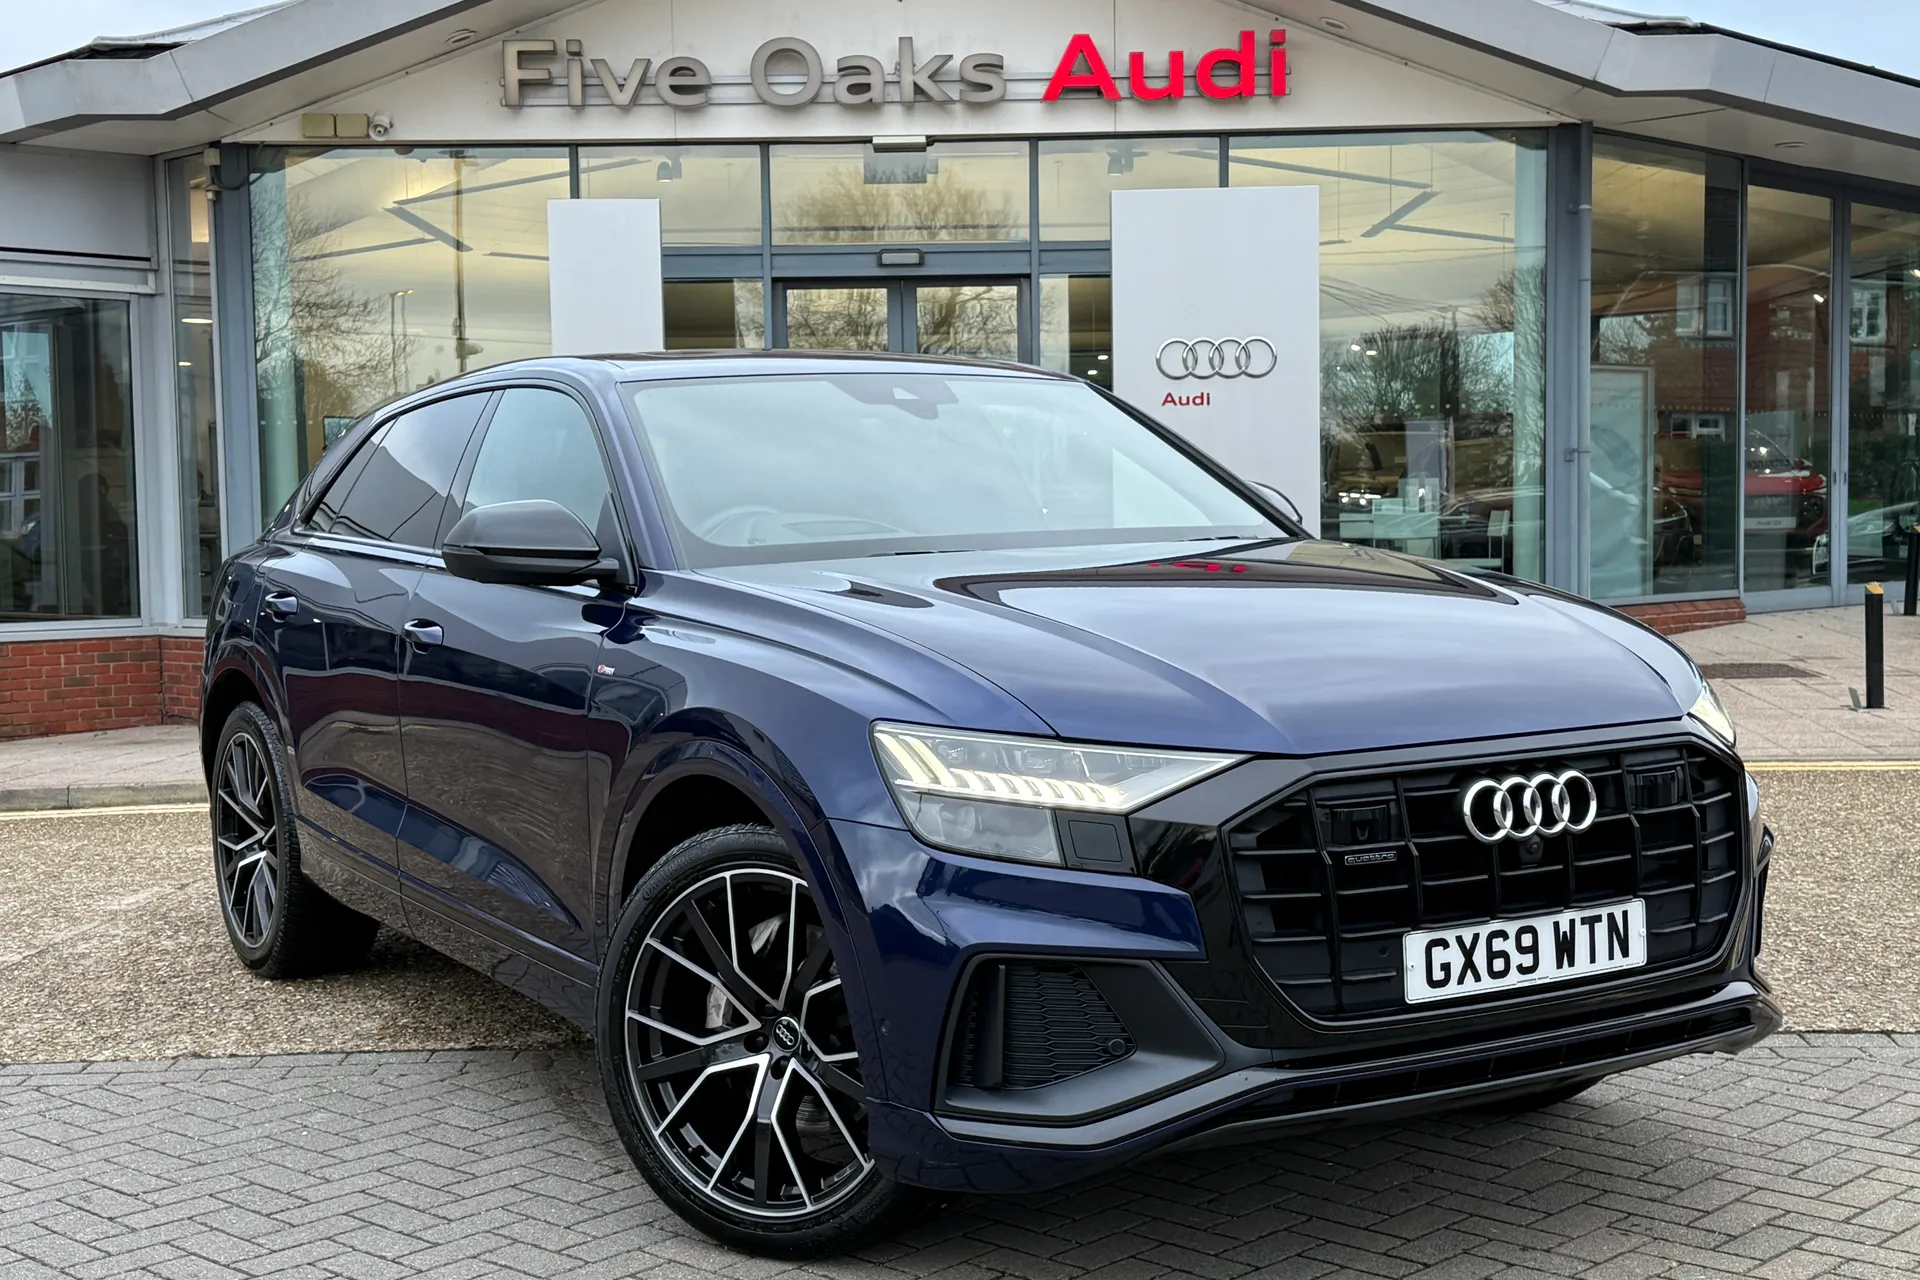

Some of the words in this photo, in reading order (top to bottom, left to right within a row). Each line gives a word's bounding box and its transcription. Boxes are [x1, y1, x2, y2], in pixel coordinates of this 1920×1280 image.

[501, 38, 712, 108] Five
[750, 36, 1007, 108] Oaks
[1041, 29, 1287, 103] Audi
[1161, 392, 1211, 406] Audi
[1347, 853, 1396, 863] quattro
[1424, 924, 1540, 989] GX69
[1552, 909, 1630, 970] WTN
